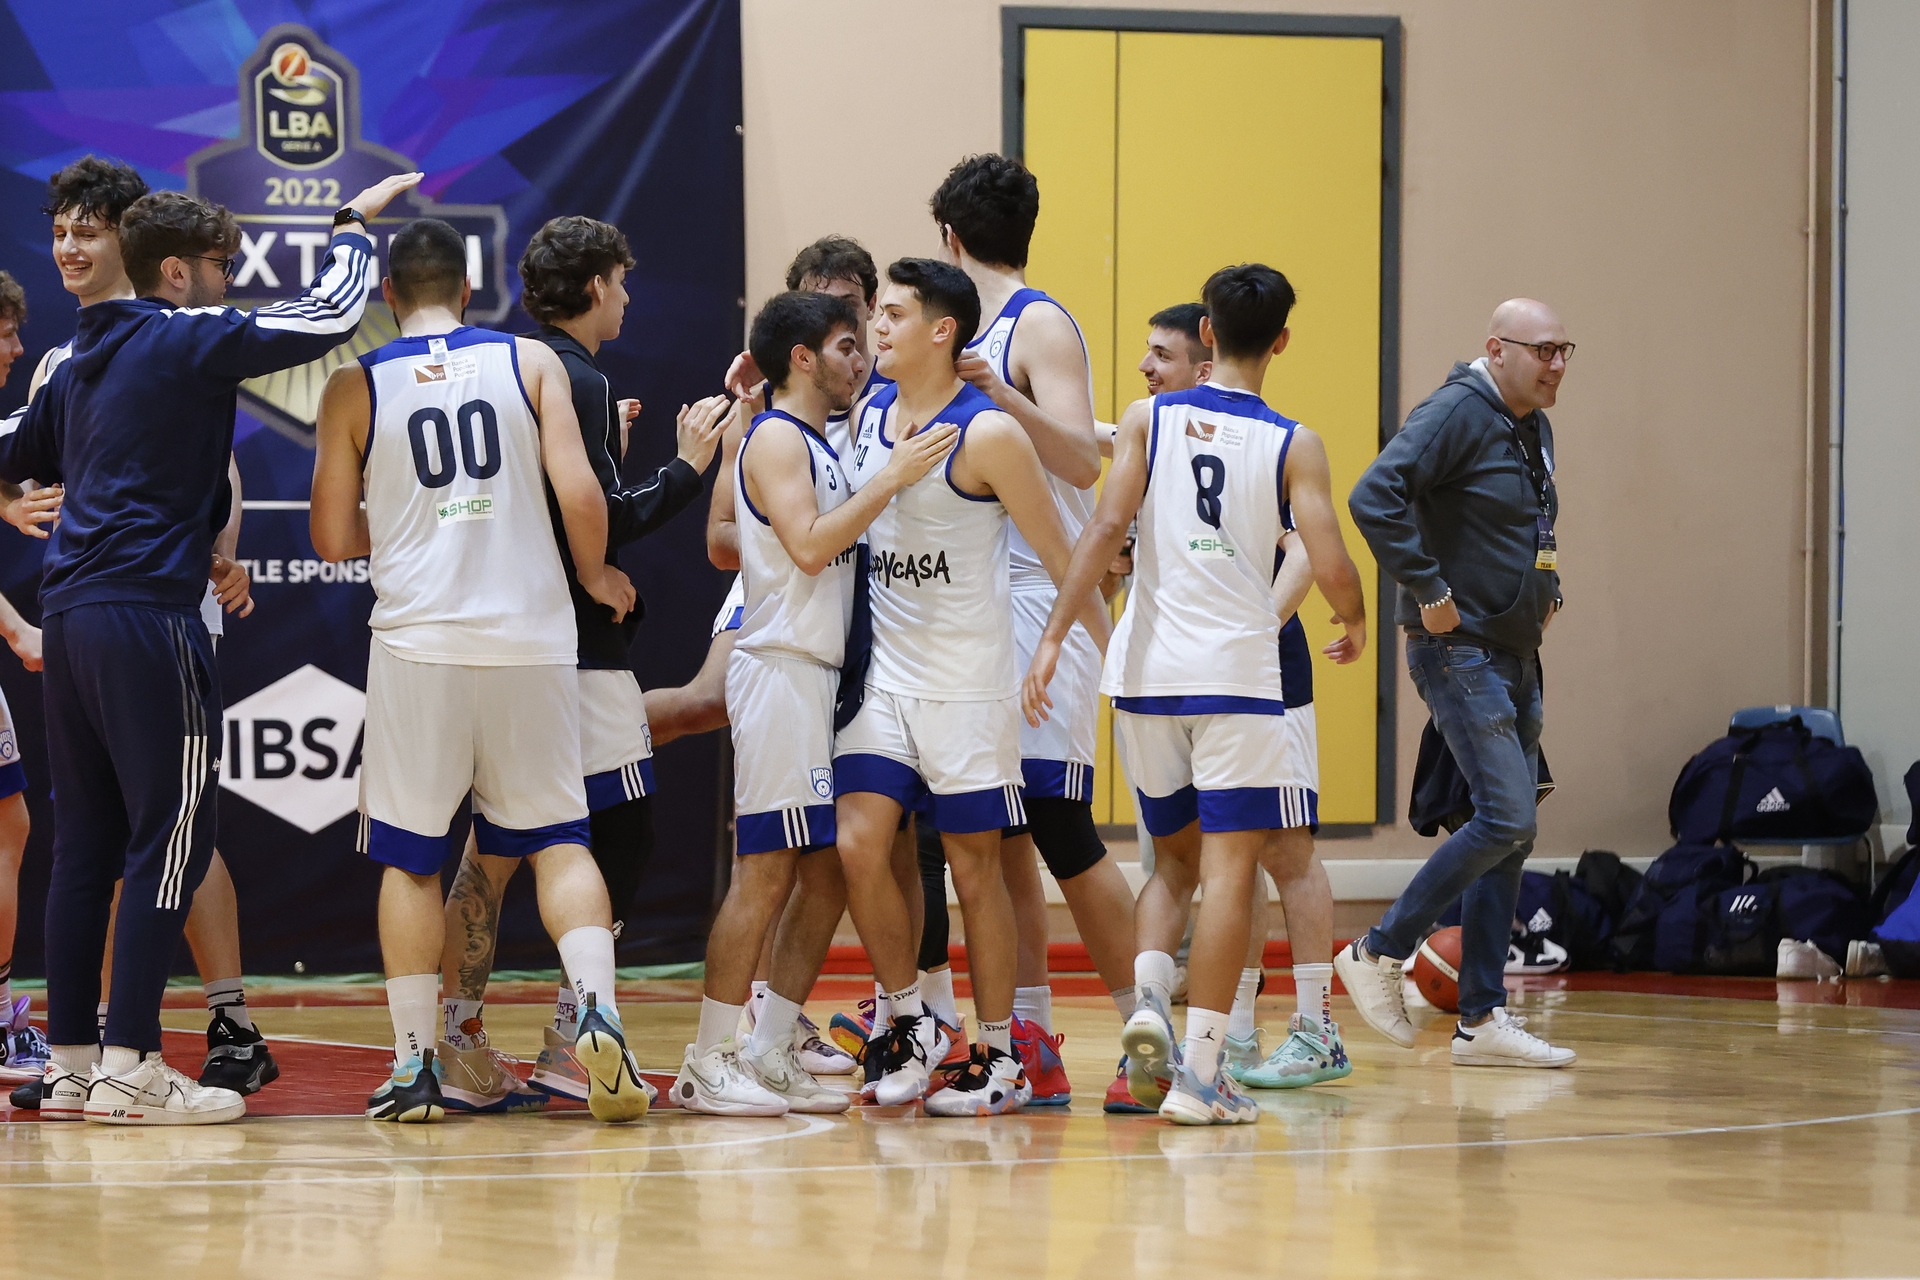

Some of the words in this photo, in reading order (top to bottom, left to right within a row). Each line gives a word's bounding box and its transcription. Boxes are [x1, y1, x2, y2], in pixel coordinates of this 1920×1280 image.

[269, 110, 333, 138] LBA
[265, 177, 342, 206] 2022
[407, 399, 502, 488] 00
[826, 464, 837, 490] 3
[1191, 453, 1225, 531] 8
[449, 499, 492, 516] SHOP
[287, 559, 372, 583] SPONS
[111, 1109, 126, 1118] AIR
